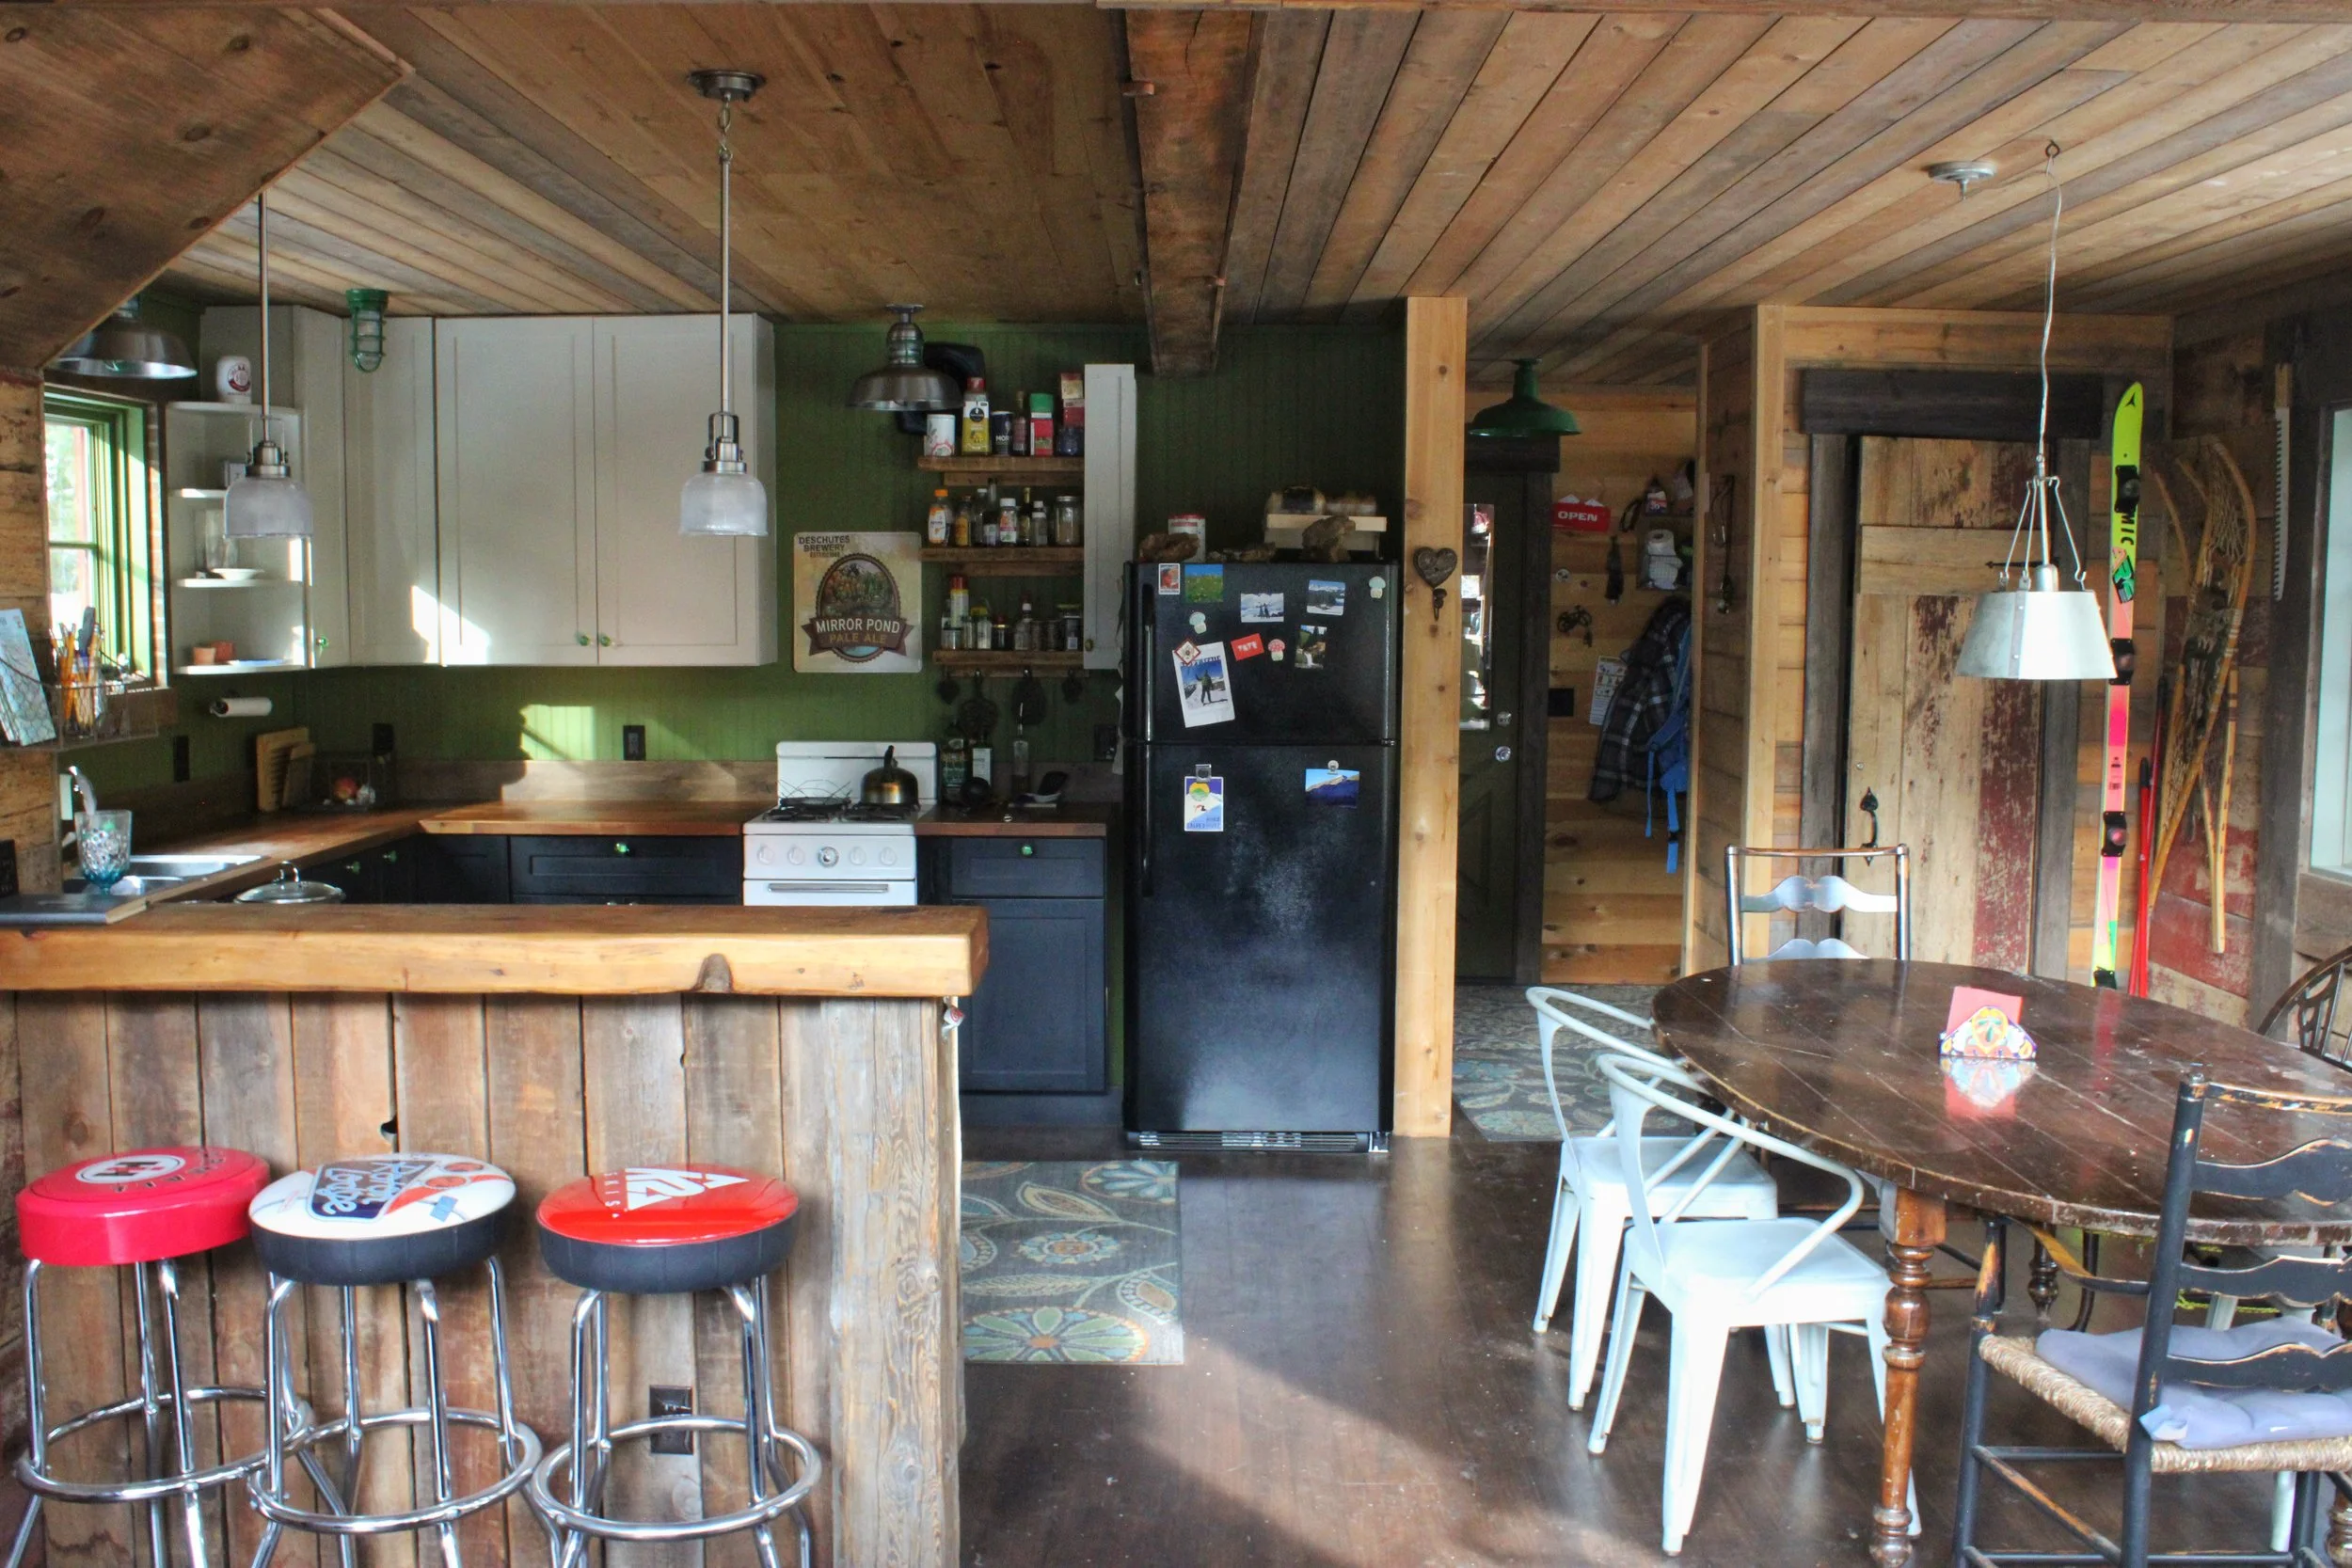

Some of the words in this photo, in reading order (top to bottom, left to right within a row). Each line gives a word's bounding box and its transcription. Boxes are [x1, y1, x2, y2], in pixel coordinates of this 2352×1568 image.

[1557, 511, 1597, 522] OPEN
[799, 535, 850, 545] DESCHUTES
[803, 544, 845, 552] BREWERY
[816, 618, 863, 633] MIRROR
[866, 618, 900, 634] POND
[829, 632, 859, 643] PALE
[864, 632, 887, 643] ALE
[315, 1166, 373, 1215] Lodge
[604, 1171, 621, 1208] SKIS
[625, 1166, 750, 1212] K2
